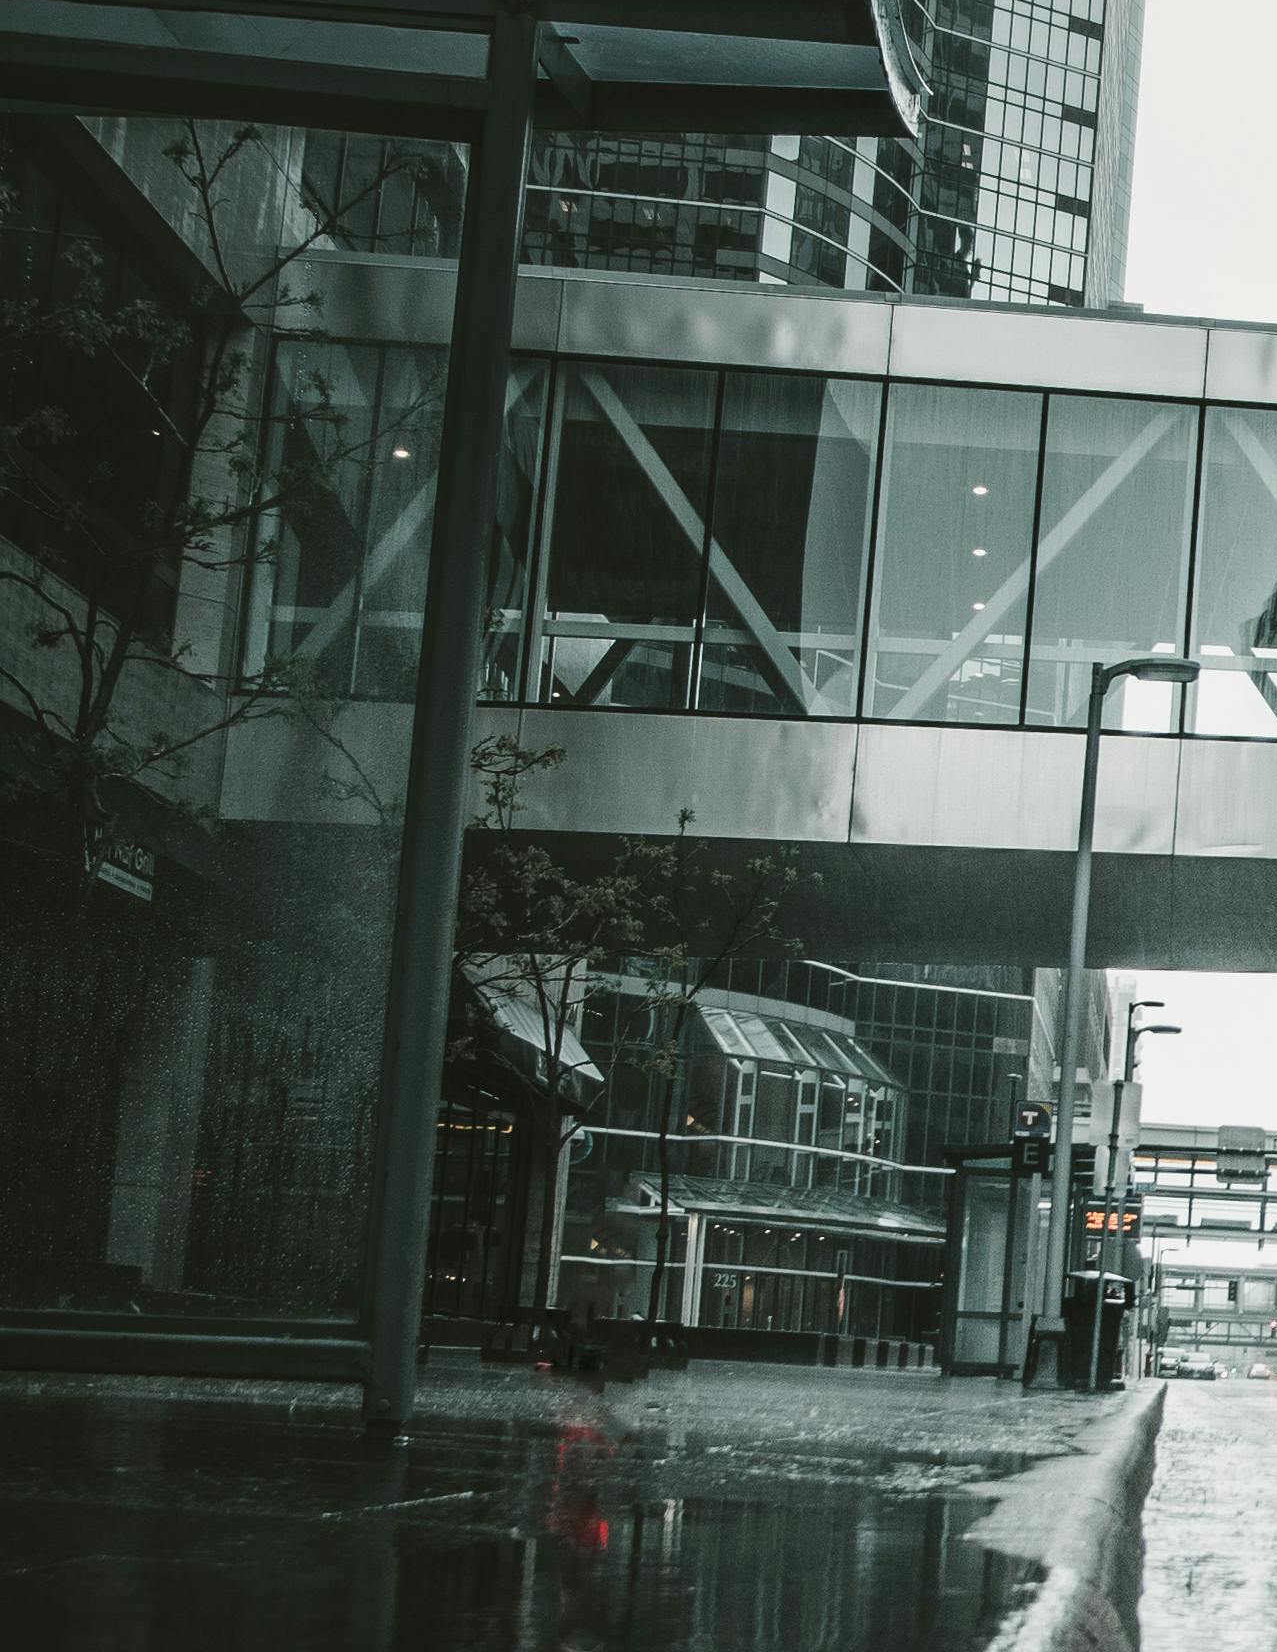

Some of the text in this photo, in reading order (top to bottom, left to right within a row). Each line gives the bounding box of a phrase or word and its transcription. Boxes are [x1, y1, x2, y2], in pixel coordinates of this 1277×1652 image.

[1022, 1111, 1039, 1125] T
[1023, 1143, 1039, 1165] E
[713, 1273, 737, 1289] 225
